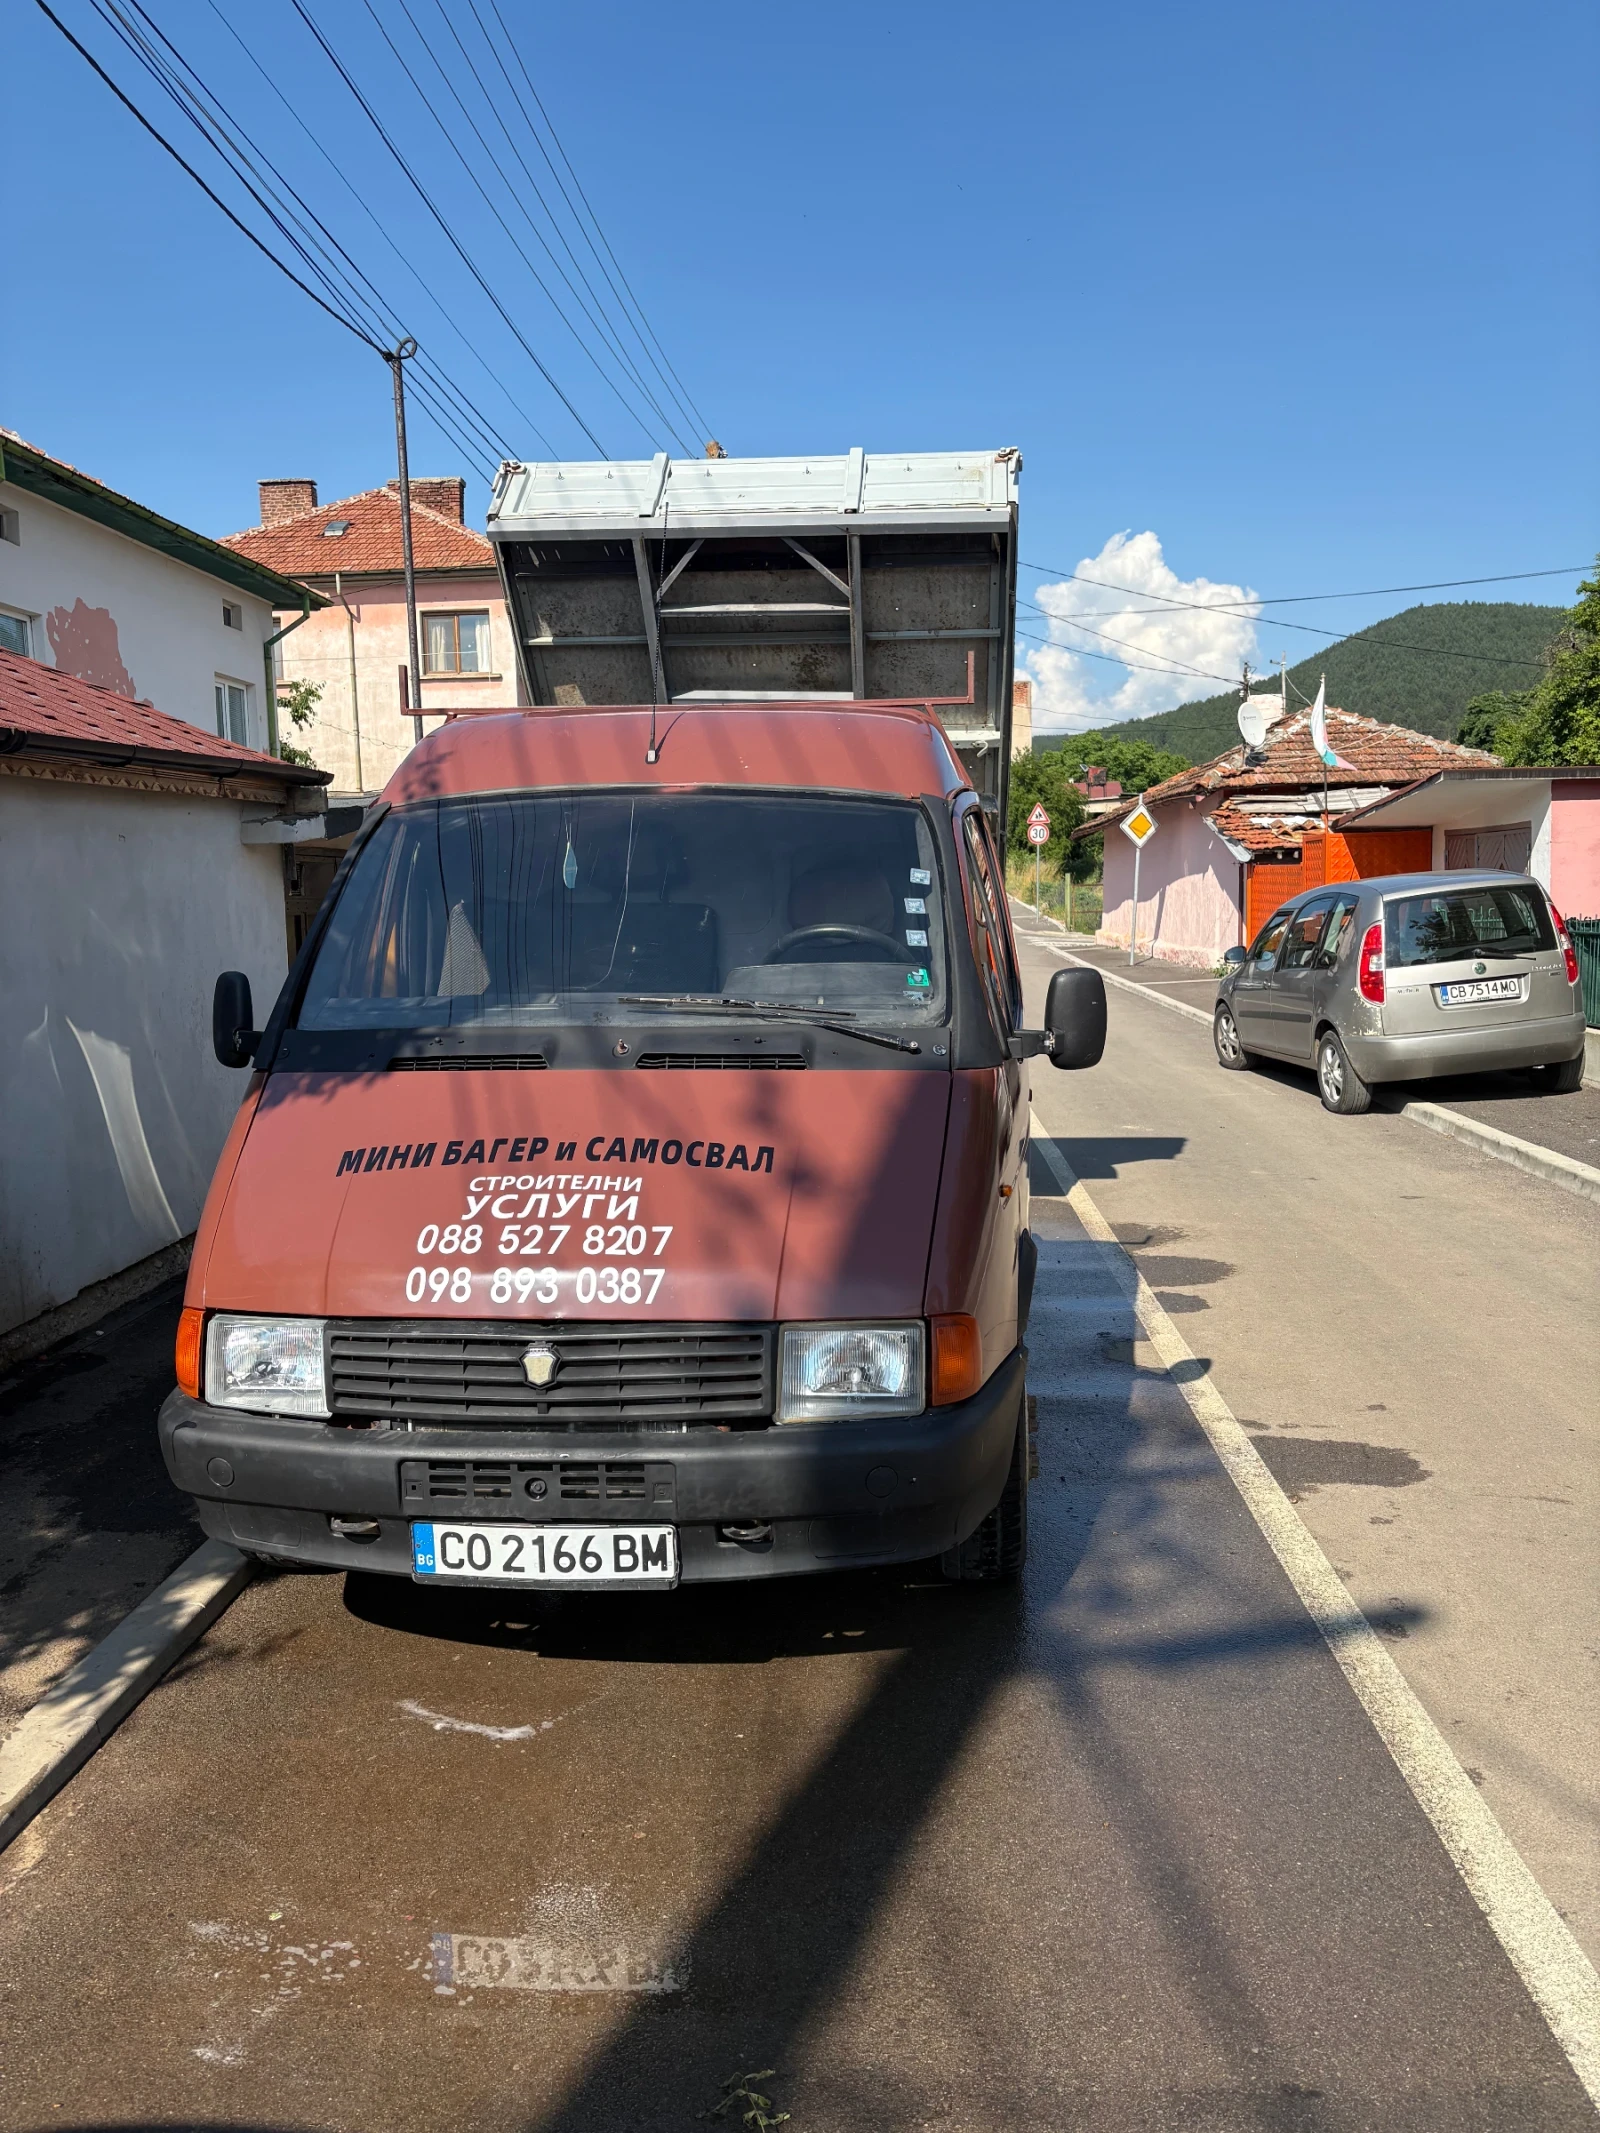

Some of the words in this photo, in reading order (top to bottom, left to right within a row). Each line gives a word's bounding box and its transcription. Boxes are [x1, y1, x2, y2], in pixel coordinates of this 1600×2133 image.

[1032, 828, 1045, 839] 30
[1450, 986, 1467, 999] CB
[1468, 982, 1499, 997] 7514
[1500, 980, 1517, 994] MO
[336, 1142, 438, 1177] МИНИ
[441, 1137, 549, 1166] БАГЕР
[585, 1136, 775, 1173] САМОСВАЛ
[469, 1175, 643, 1193] СТРОИТЕЛНИ
[461, 1193, 639, 1221] УСЛУГИ
[417, 1224, 483, 1255] 088
[498, 1224, 571, 1255] 527
[582, 1225, 674, 1256] 8207
[405, 1266, 472, 1303] 098
[490, 1266, 559, 1304] 893
[576, 1266, 666, 1305] 0387
[417, 1553, 434, 1567] BG
[440, 1531, 492, 1571] CO
[501, 1534, 603, 1574] 2166
[612, 1533, 669, 1573] BM
